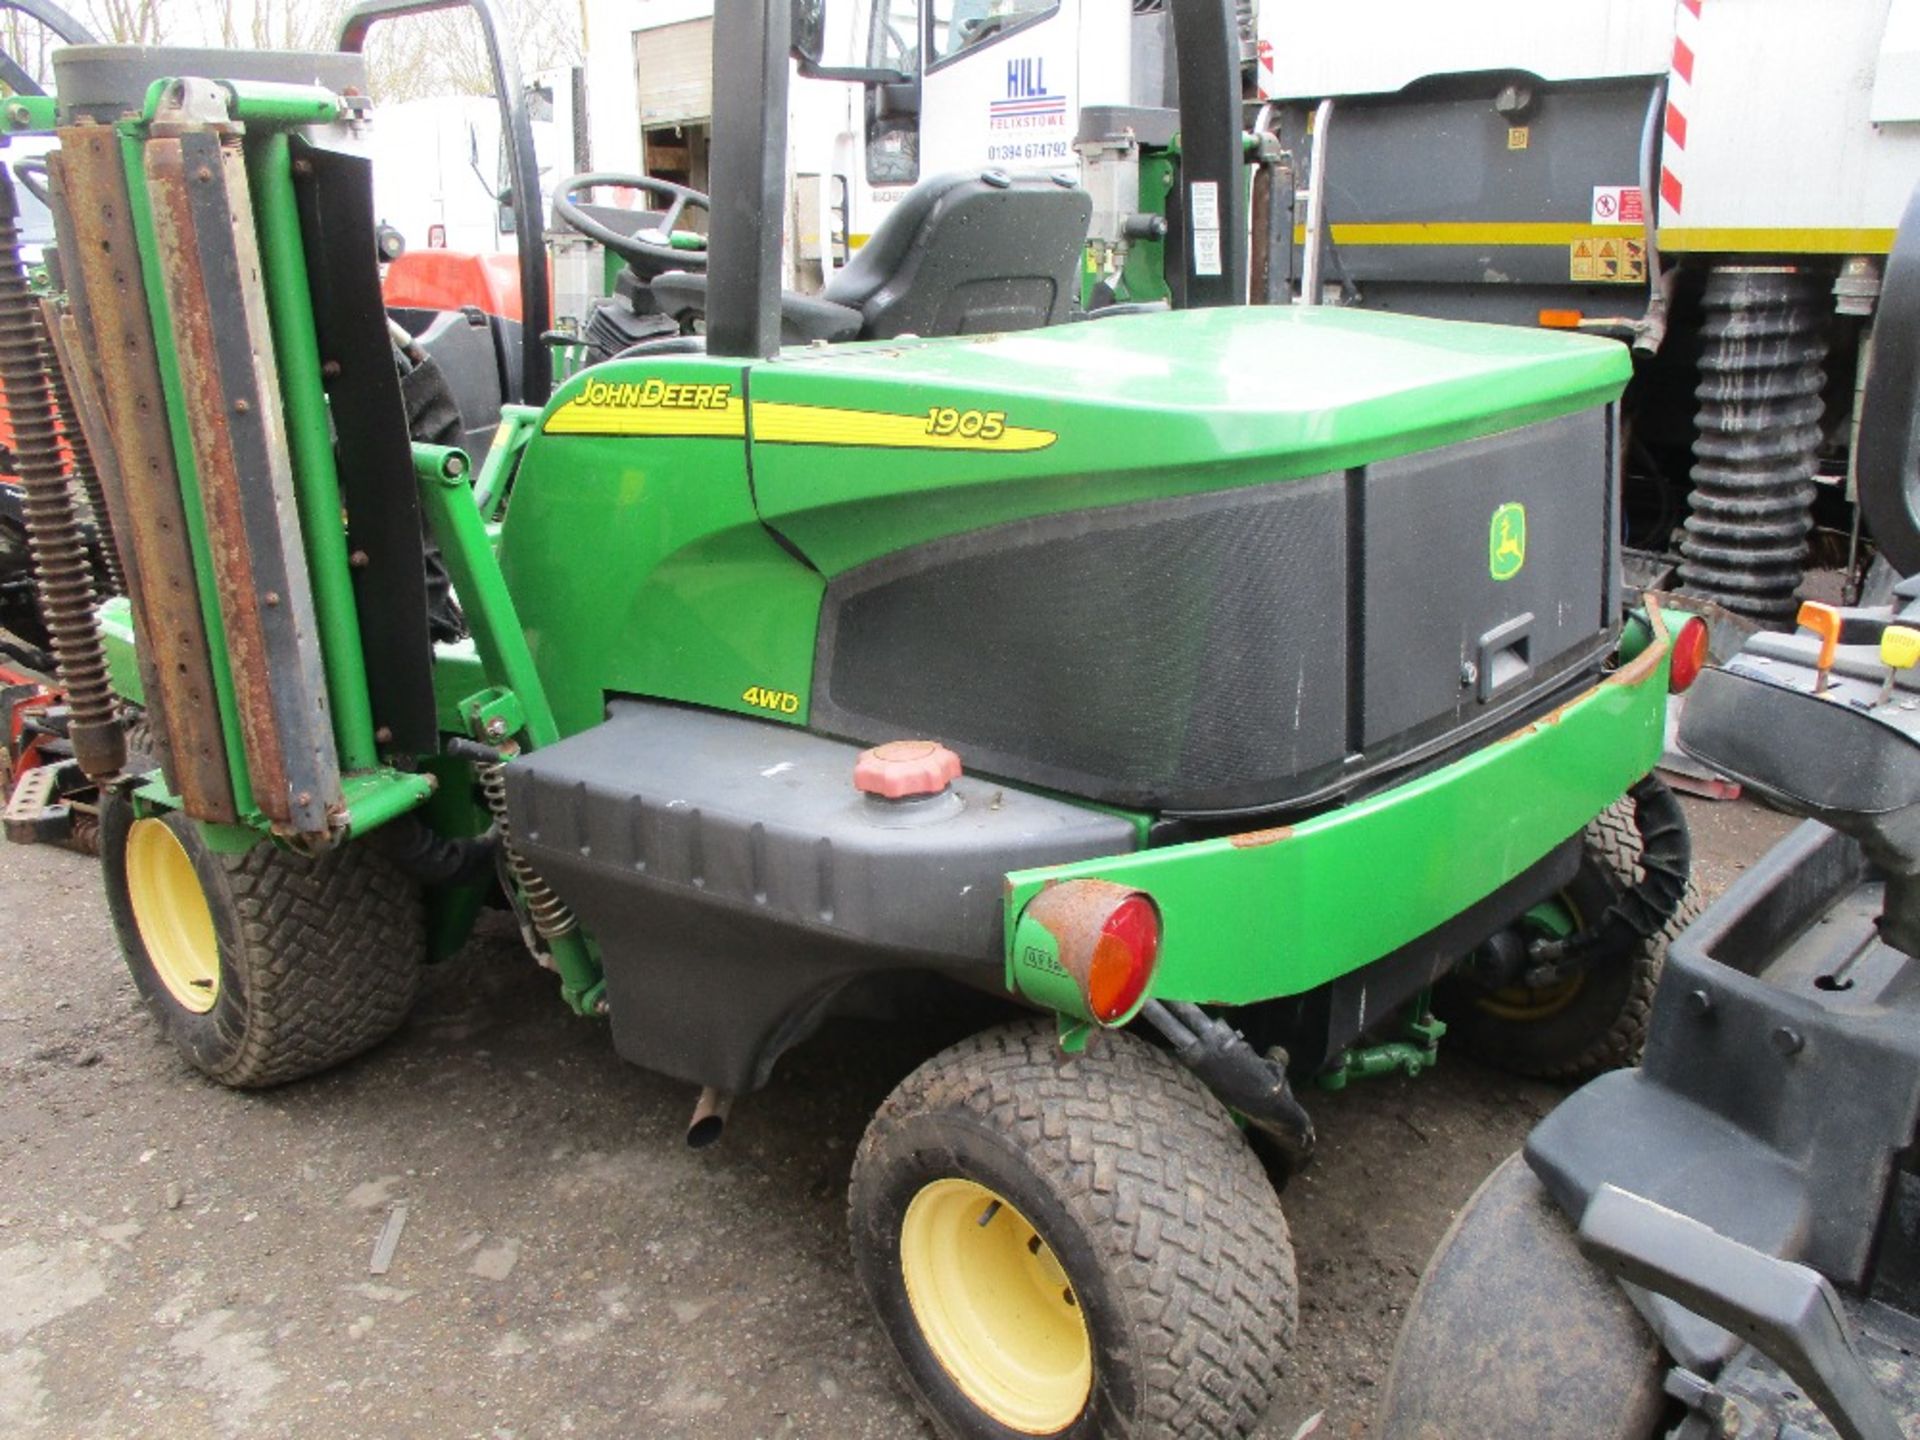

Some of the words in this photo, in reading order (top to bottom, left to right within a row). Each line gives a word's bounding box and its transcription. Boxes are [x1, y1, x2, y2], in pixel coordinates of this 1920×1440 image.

[1007, 57, 1047, 98] HILL
[990, 115, 1065, 131] FELIXSTOWE
[988, 144, 1022, 161] 01394
[1025, 141, 1067, 159] 674792
[575, 377, 640, 407] JOHN
[640, 378, 732, 410] DEERE
[925, 406, 1007, 440] 1905
[741, 685, 800, 714] 4WD
